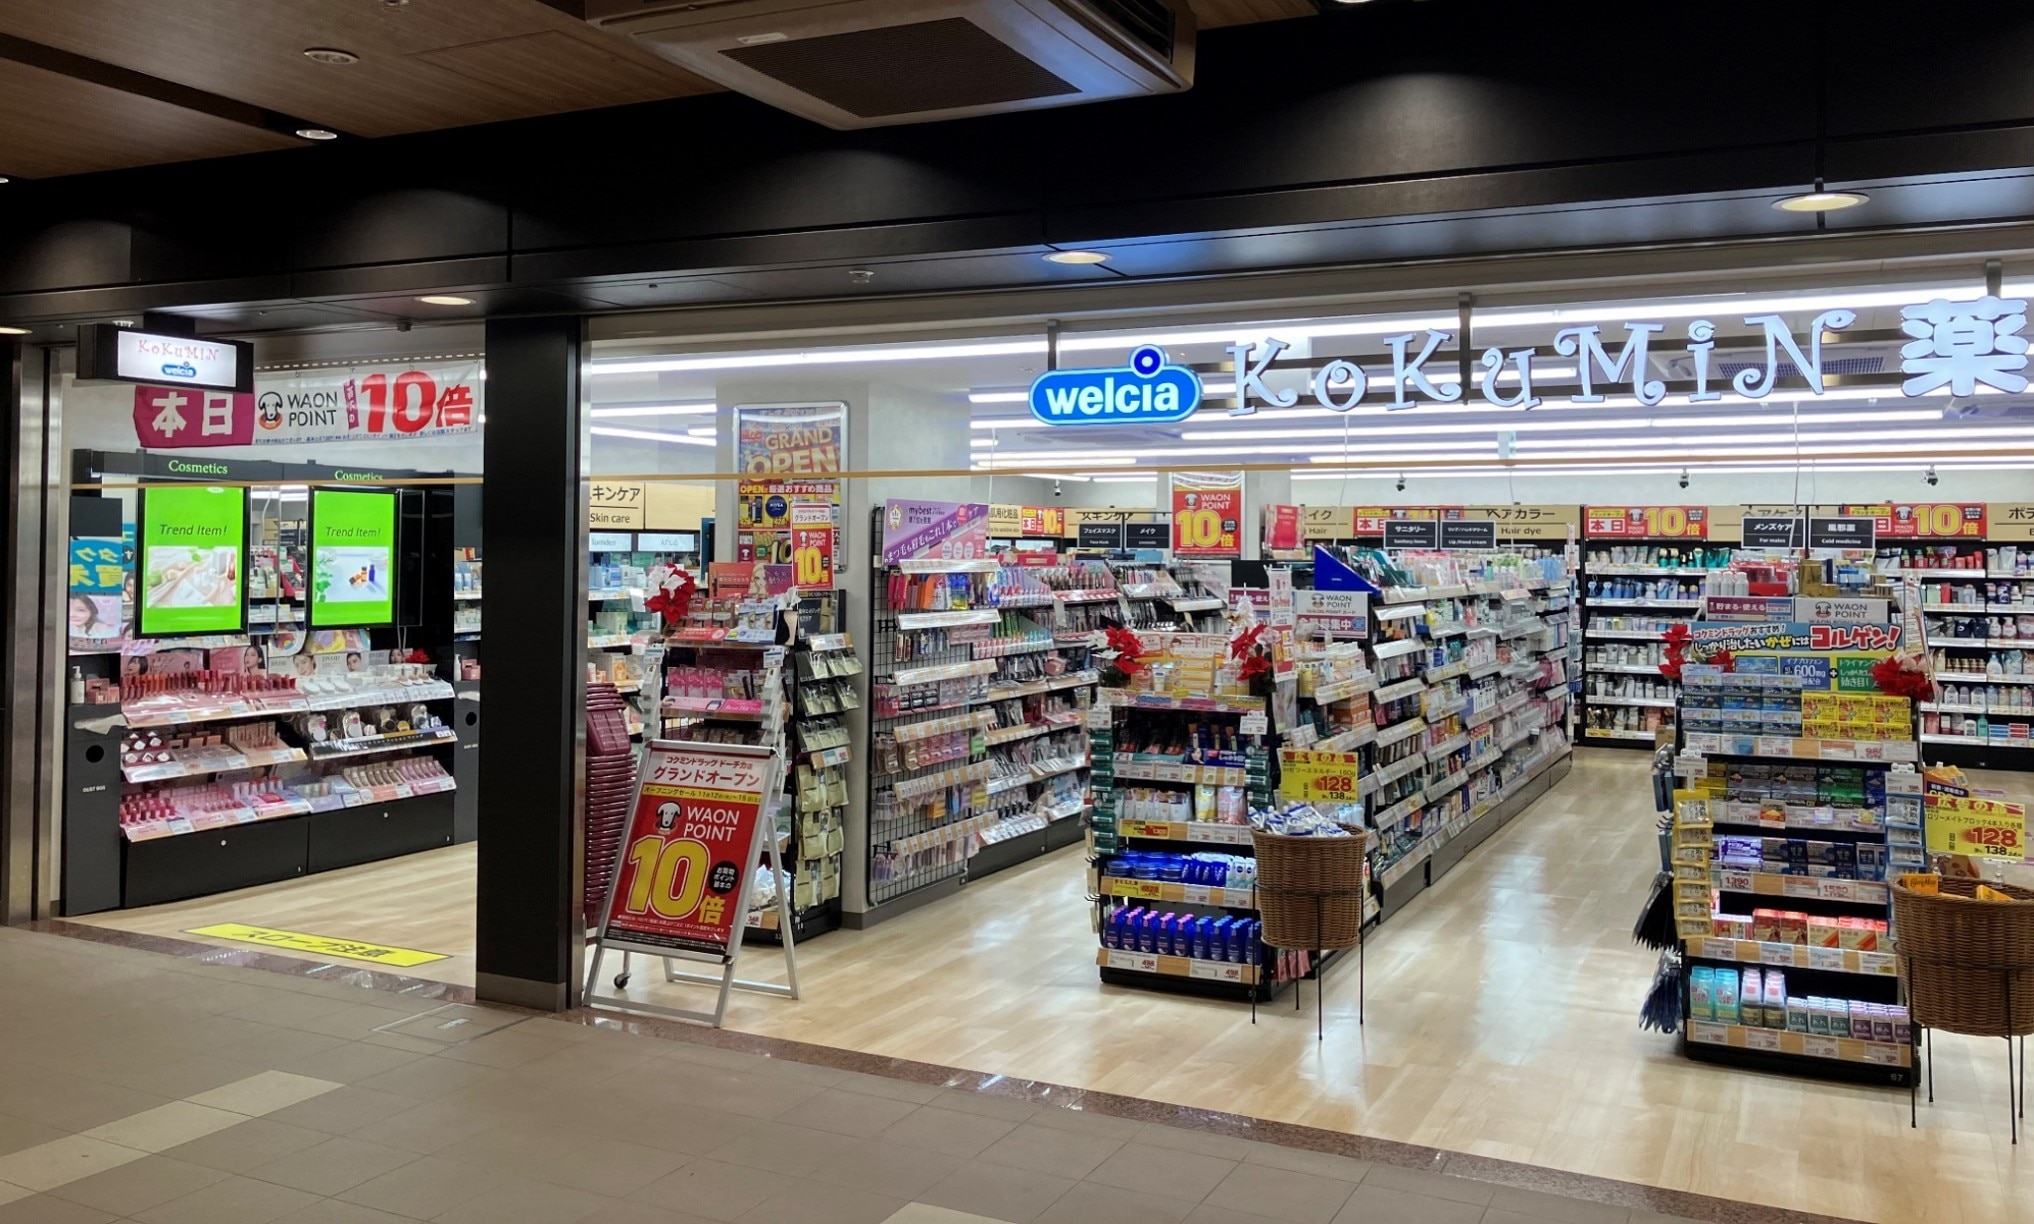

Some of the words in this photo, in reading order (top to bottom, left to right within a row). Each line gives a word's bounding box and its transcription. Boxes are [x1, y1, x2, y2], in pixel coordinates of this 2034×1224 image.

[1901, 296, 2030, 398] 薬
[165, 365, 194, 377] welcia
[287, 391, 338, 408] WAON
[361, 370, 473, 433] 10倍
[1045, 377, 1179, 415] welcia
[152, 391, 232, 437] 本日
[288, 409, 337, 427] POINT
[765, 427, 832, 450] GRAND
[168, 459, 228, 475] Cosmetics
[747, 446, 838, 481] OPEN
[335, 470, 383, 480] Cosmetics
[590, 485, 641, 502] キンケア
[1200, 494, 1231, 502] WAON
[908, 506, 932, 515] mybest
[1201, 502, 1231, 510] POINT
[590, 512, 609, 523] Skin
[611, 514, 630, 524] care
[1304, 510, 1332, 520] イク
[1487, 508, 1555, 519] ヘアカラー
[1912, 505, 1979, 536] 10倍
[1175, 509, 1235, 548] 10倍
[1395, 525, 1427, 533] サニタリー
[1590, 520, 1624, 532] 本日
[1643, 508, 1700, 536] 10倍
[1754, 523, 1792, 531] メンズケア
[159, 524, 194, 537] Trend
[196, 524, 228, 537] Item!
[325, 526, 353, 538] Trend
[355, 526, 382, 538] Item!
[808, 531, 827, 539] WAON
[1524, 528, 1542, 536] dye
[809, 539, 826, 547] POINT
[794, 546, 829, 585] 10倍
[1834, 603, 1868, 611] WAON
[1811, 625, 1900, 650] コルゲン!
[1794, 665, 1826, 677] 600mg
[666, 755, 718, 767] コクミンドラッグ
[654, 766, 760, 787] グランドオープン
[1319, 775, 1352, 792] 128
[644, 786, 696, 797] オープニングセール
[686, 805, 740, 826] WAON
[683, 823, 736, 842] POINT
[1971, 827, 2017, 848] 128
[1985, 845, 2007, 855] 138
[625, 834, 726, 925] 10倍
